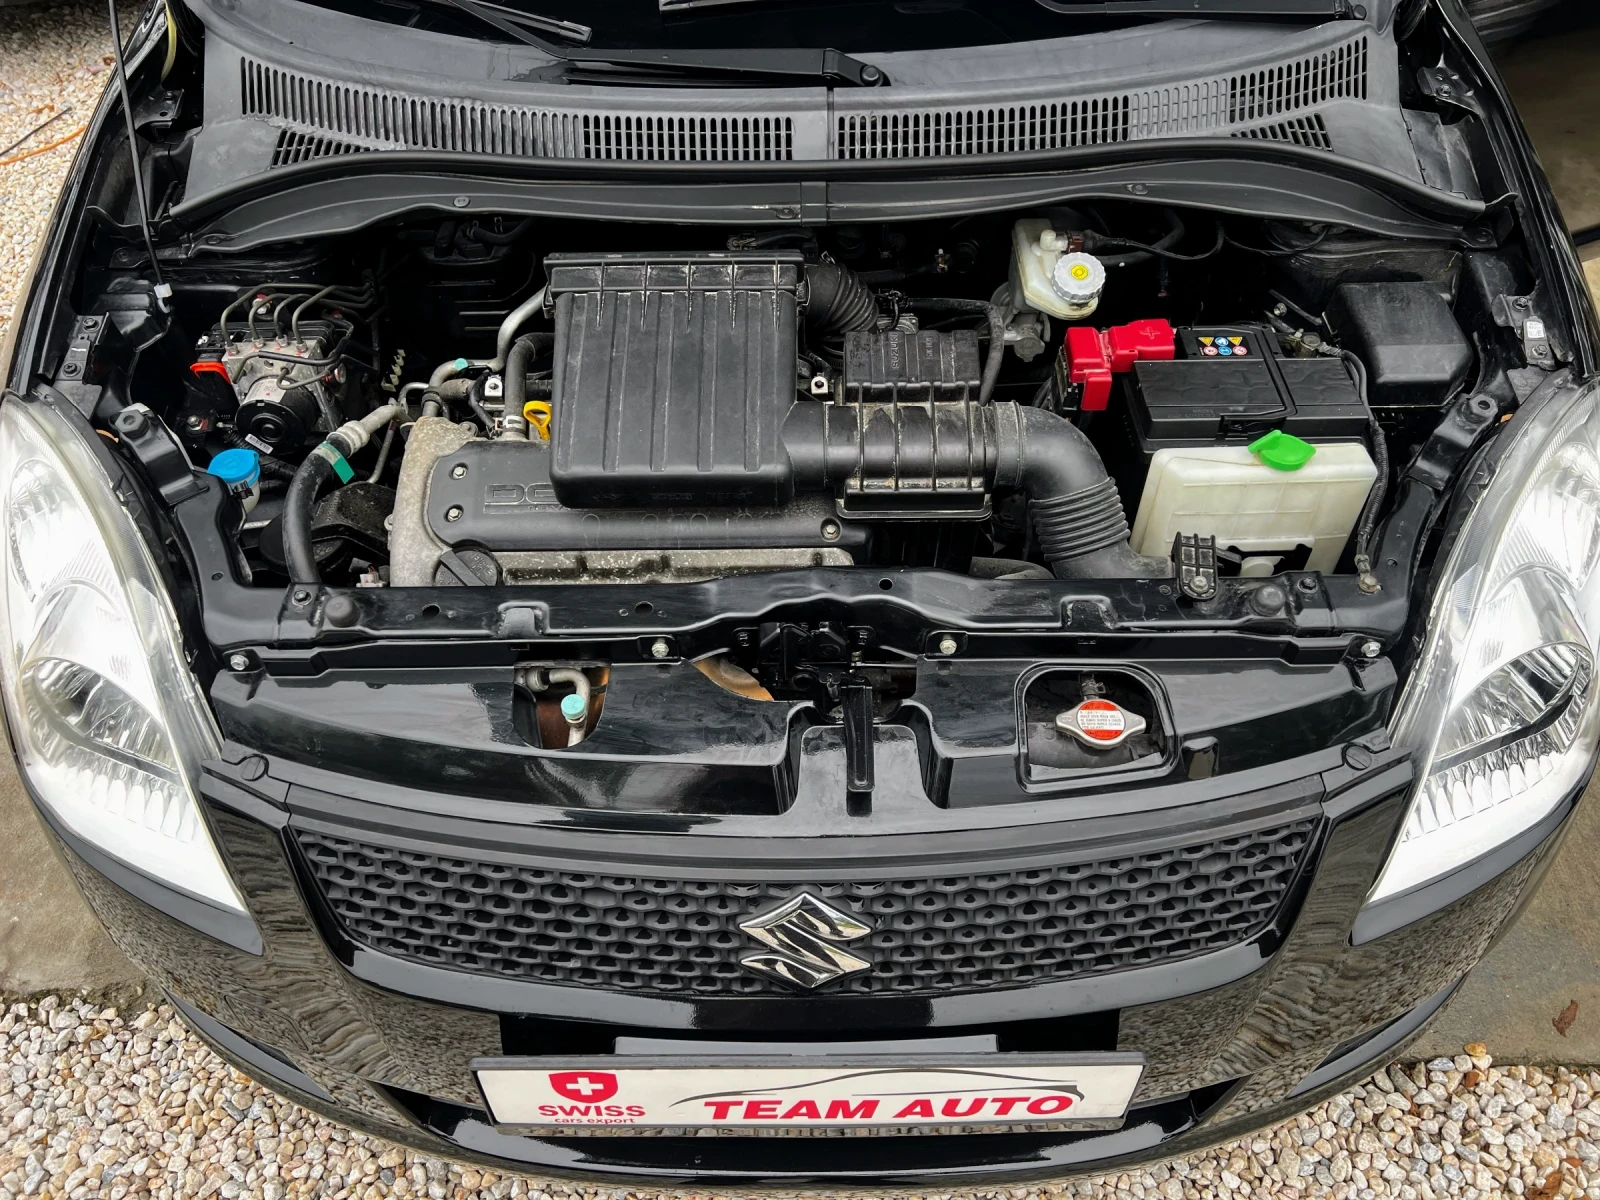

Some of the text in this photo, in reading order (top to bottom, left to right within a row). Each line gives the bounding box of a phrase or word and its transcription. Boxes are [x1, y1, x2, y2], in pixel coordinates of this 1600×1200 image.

[889, 332, 899, 369] SUZUKI
[538, 1105, 646, 1117] SWISS
[703, 1096, 1074, 1120] TEAM AUTO
